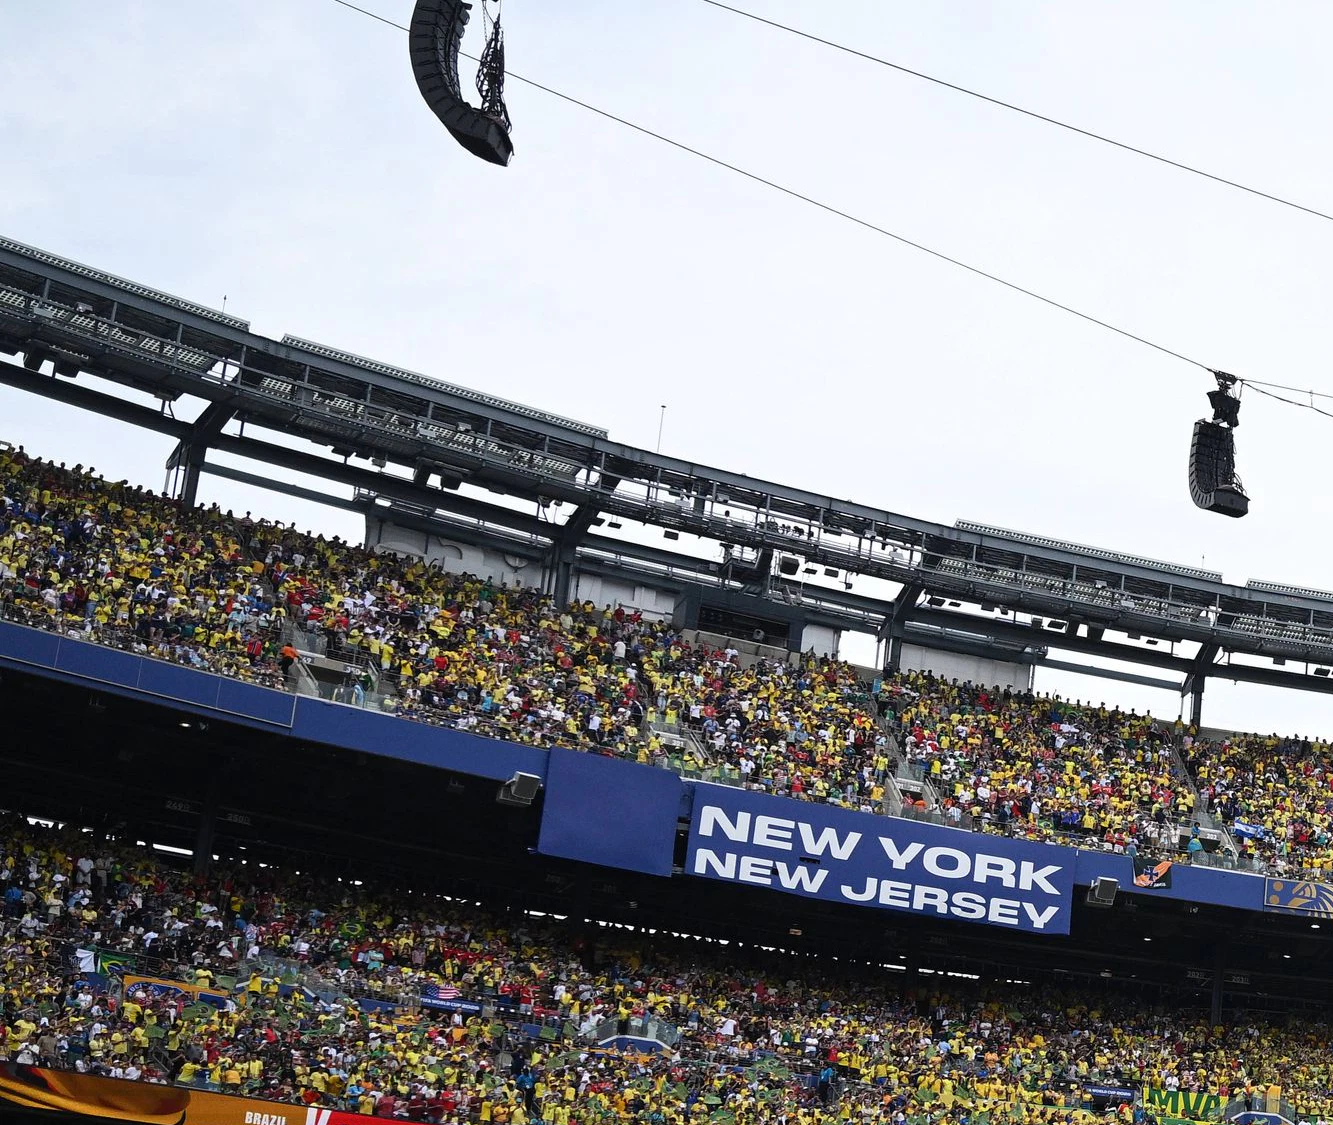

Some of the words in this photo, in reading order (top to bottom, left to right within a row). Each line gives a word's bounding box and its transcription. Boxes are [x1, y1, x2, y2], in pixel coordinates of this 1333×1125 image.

[694, 847, 829, 894] NEW
[840, 876, 1060, 930] JERSEY
[698, 805, 862, 861] NEW
[878, 836, 1063, 896] YORK
[432, 999, 451, 1007] WORLD
